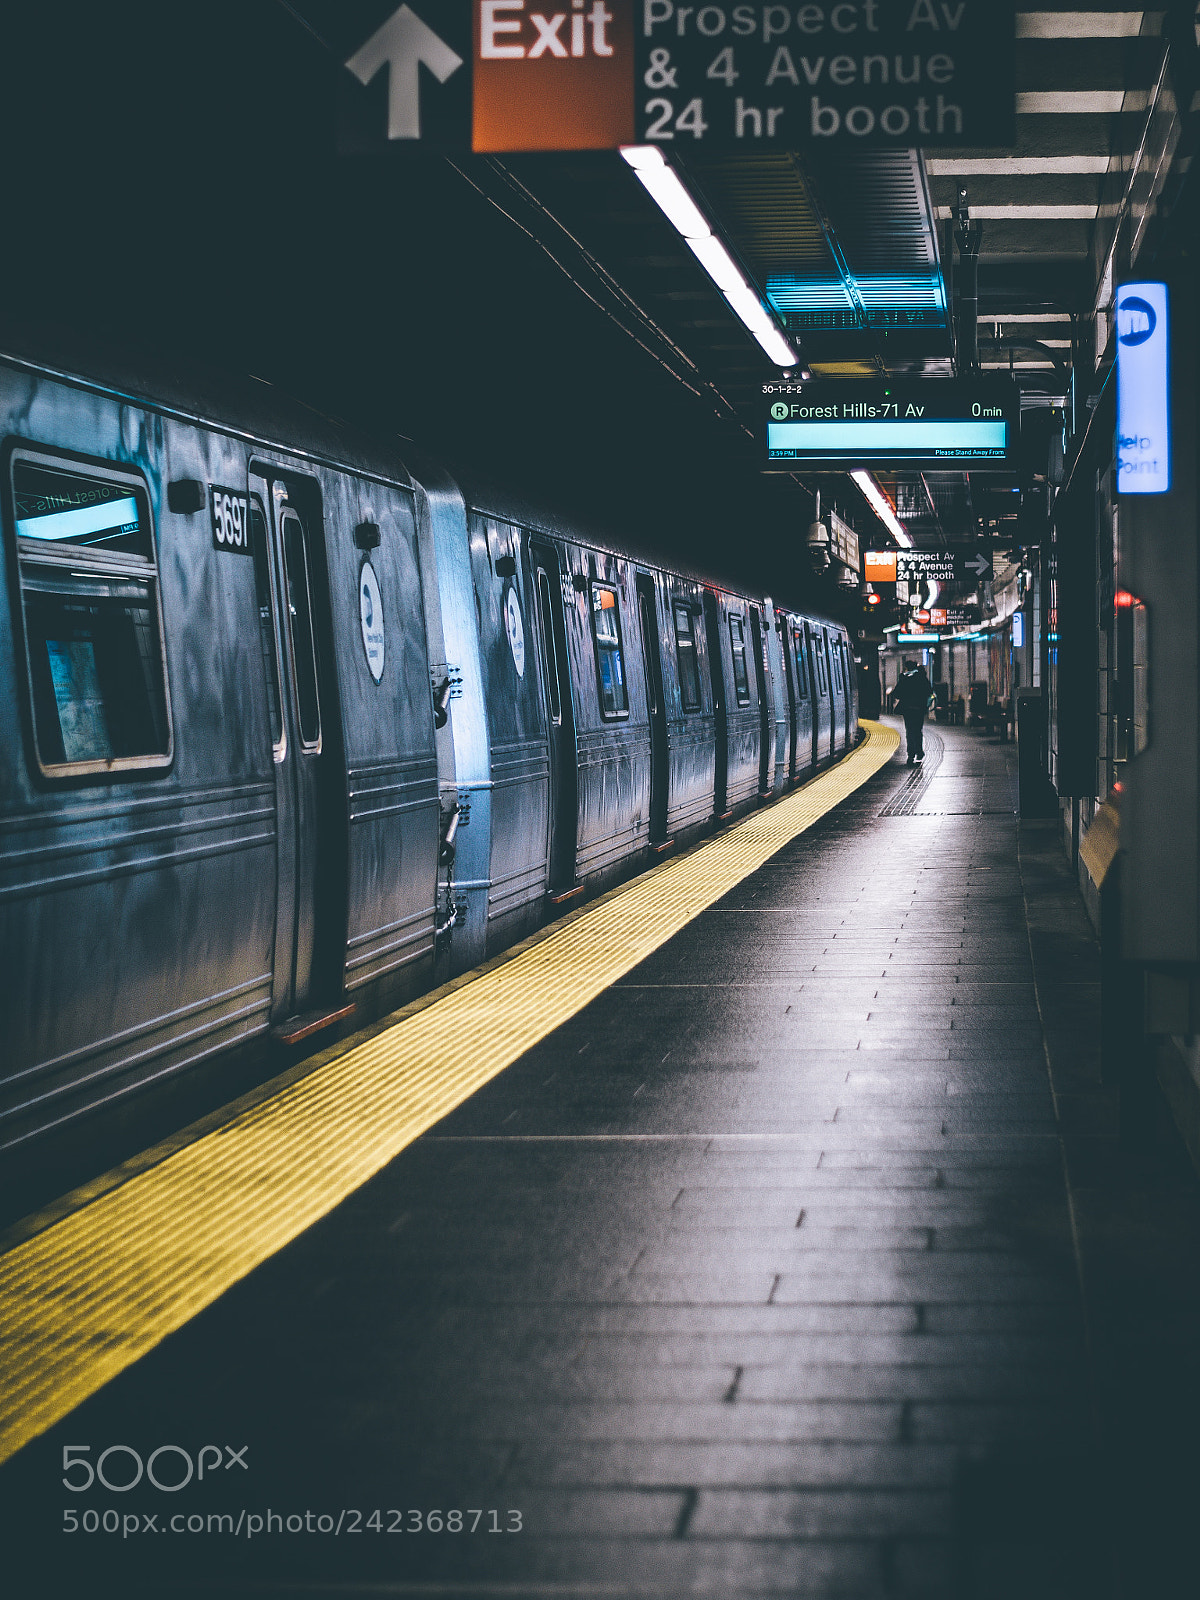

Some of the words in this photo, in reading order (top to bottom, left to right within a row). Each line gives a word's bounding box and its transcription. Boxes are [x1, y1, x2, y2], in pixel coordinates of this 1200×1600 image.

[480, 0, 614, 59] Exit
[643, 0, 880, 43] Prospect
[905, 0, 966, 32] Av
[643, 47, 679, 90] &
[705, 46, 741, 88] 4
[765, 45, 955, 87] Avenue
[644, 97, 709, 141] 24
[735, 96, 784, 139] hr
[810, 94, 963, 136] booth
[761, 385, 802, 394] 30-1-2-2
[790, 404, 839, 418] Forest
[843, 402, 898, 418] Hills-71
[905, 402, 925, 417] Av
[971, 402, 981, 417] 0
[983, 406, 1002, 417] min
[213, 491, 248, 547] 5697
[896, 551, 940, 562] Prospect
[943, 552, 955, 561] Av
[897, 561, 905, 571] &
[908, 561, 916, 570] 4
[919, 561, 954, 571] Avenue
[897, 571, 910, 580] 24
[913, 571, 923, 580] hr
[926, 571, 954, 580] booth
